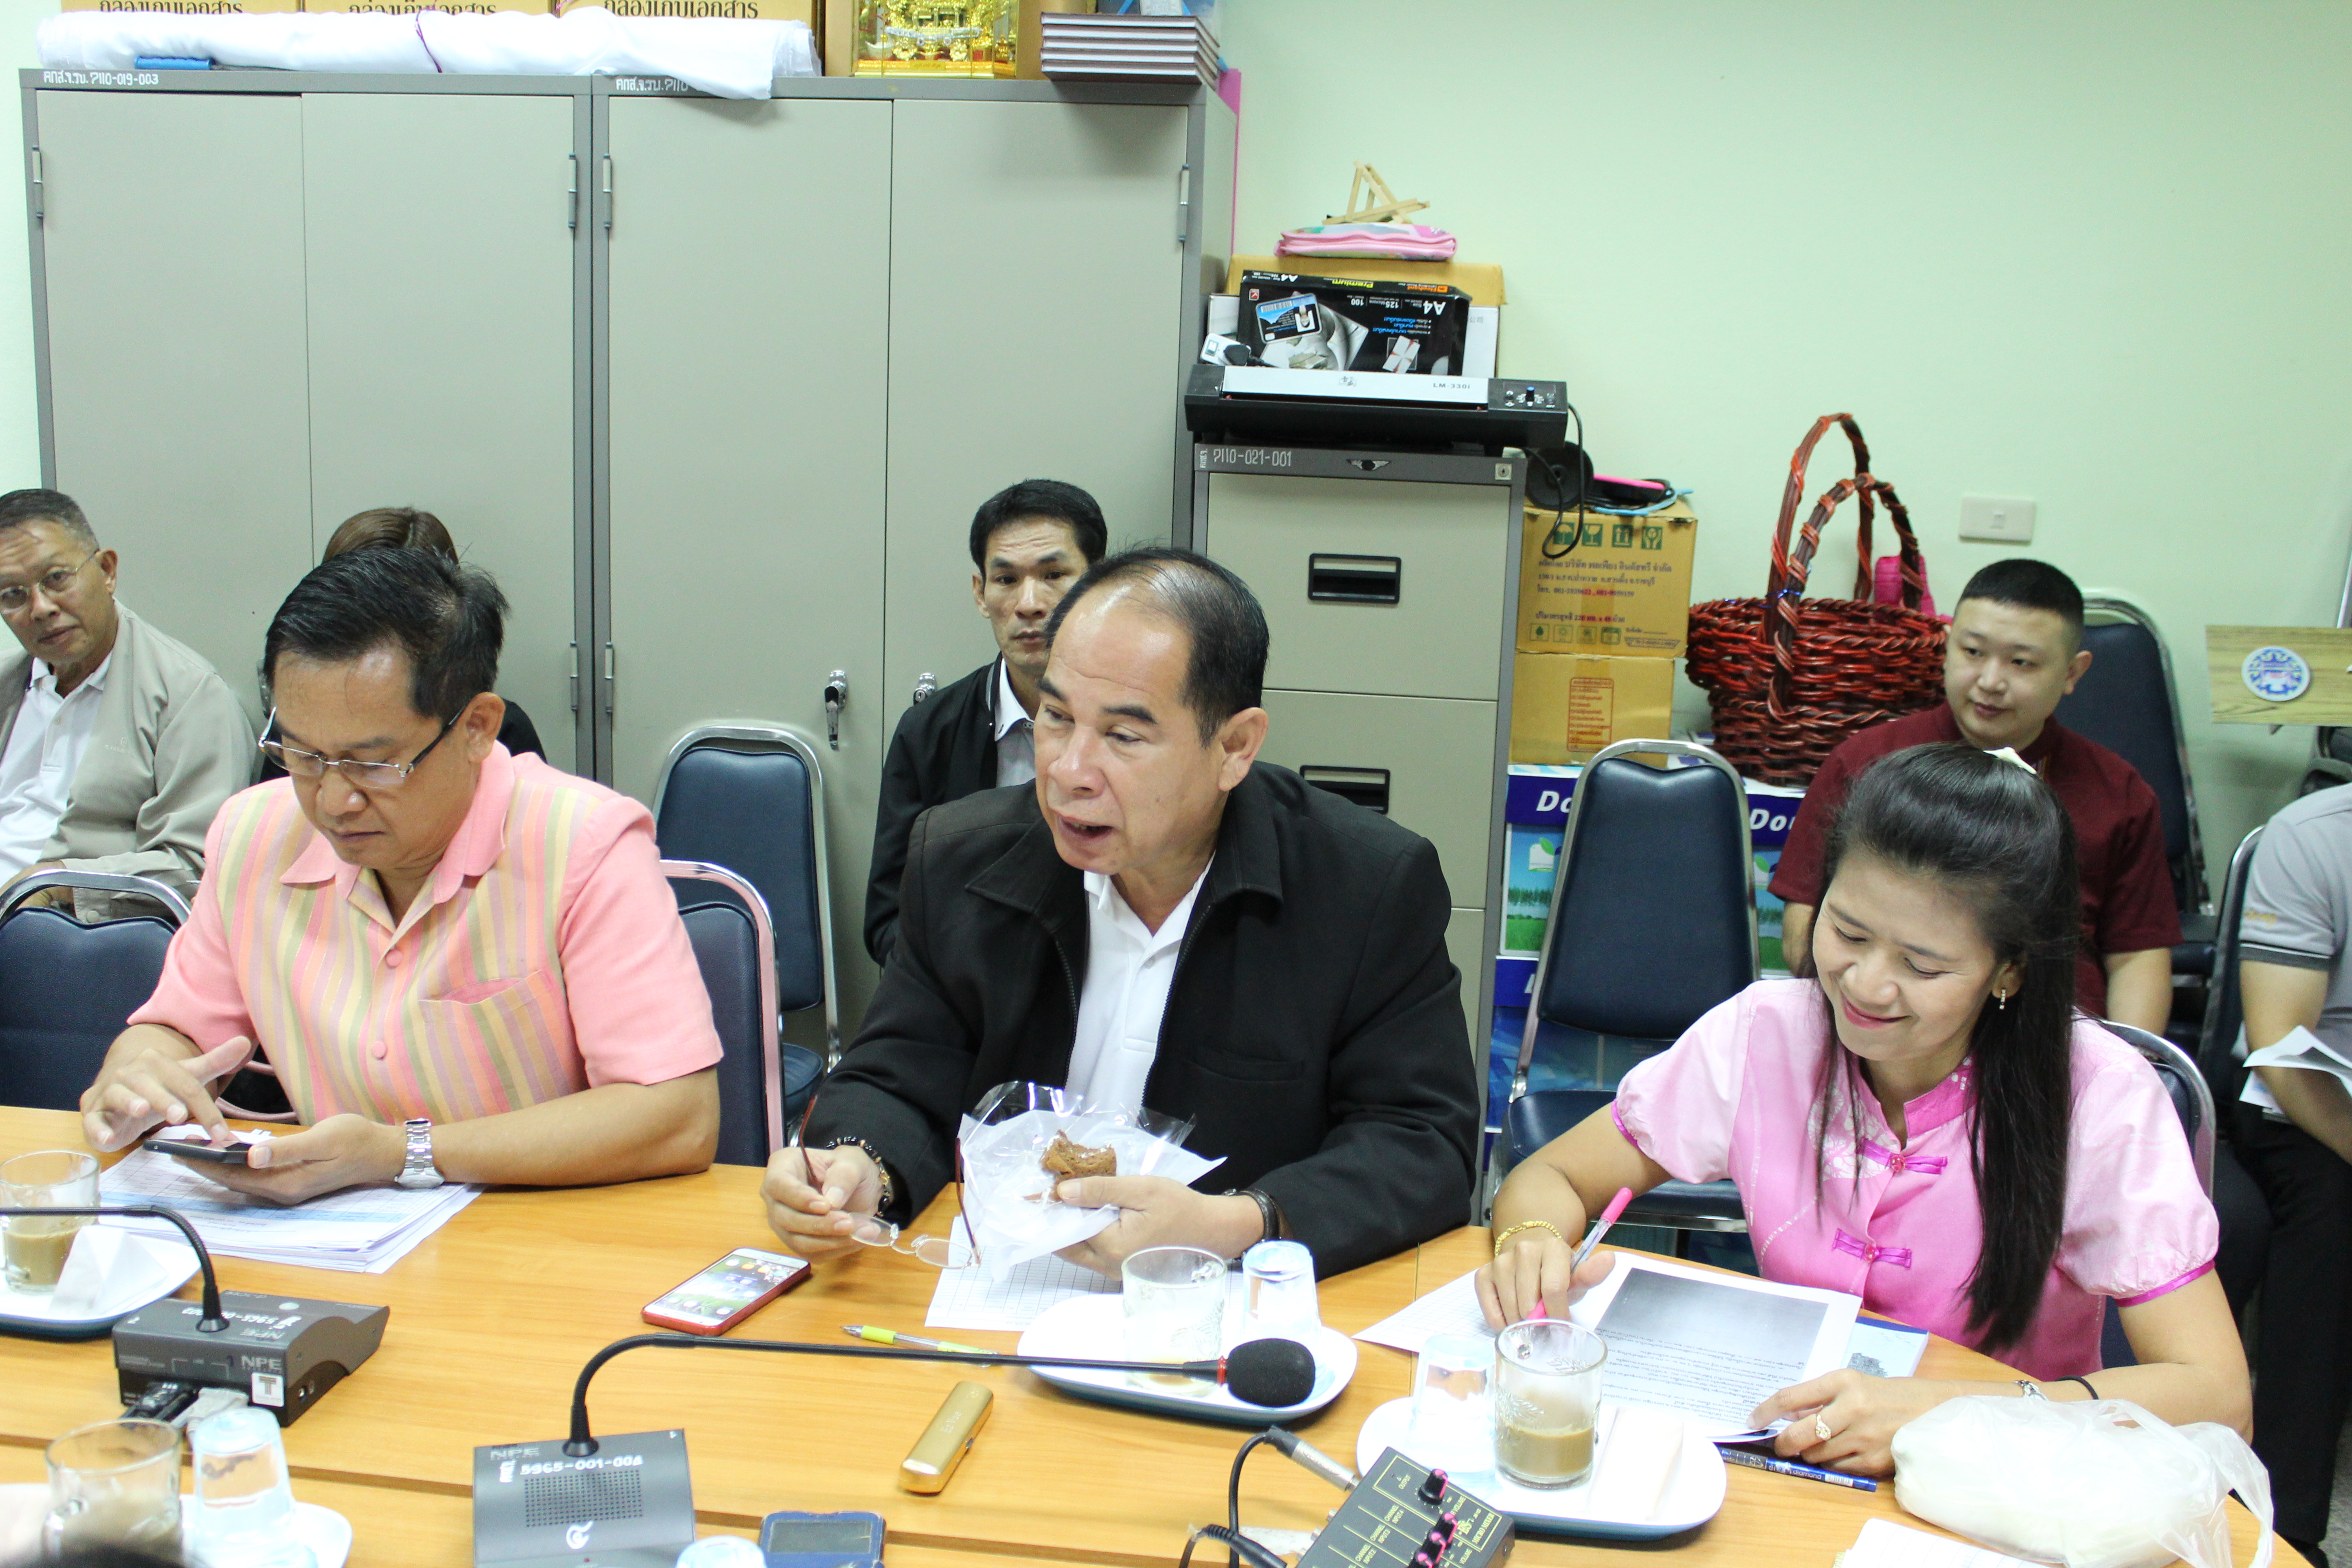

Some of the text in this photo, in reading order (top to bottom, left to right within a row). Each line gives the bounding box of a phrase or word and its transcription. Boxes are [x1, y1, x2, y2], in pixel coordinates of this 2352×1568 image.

[90, 72, 159, 86] 7110-019-003
[1332, 279, 1373, 289] Premium
[1423, 300, 1446, 315] A4
[1213, 448, 1292, 466] 7110-021-001
[1750, 808, 1795, 831] Do
[240, 1355, 283, 1368] NPE
[490, 1447, 540, 1459] NPE
[1398, 1475, 1411, 1490] OUTPUT
[1793, 1469, 1822, 1480] diamond
[1453, 1496, 1466, 1512] VOLUME
[1384, 1504, 1400, 1522] CHANNEL
[1370, 1524, 1385, 1541] CHANNEL
[1472, 1513, 1496, 1544] MICRO MIXER
[1355, 1544, 1371, 1562] CHANNEL
[1460, 1548, 1473, 1564] VOLUME
